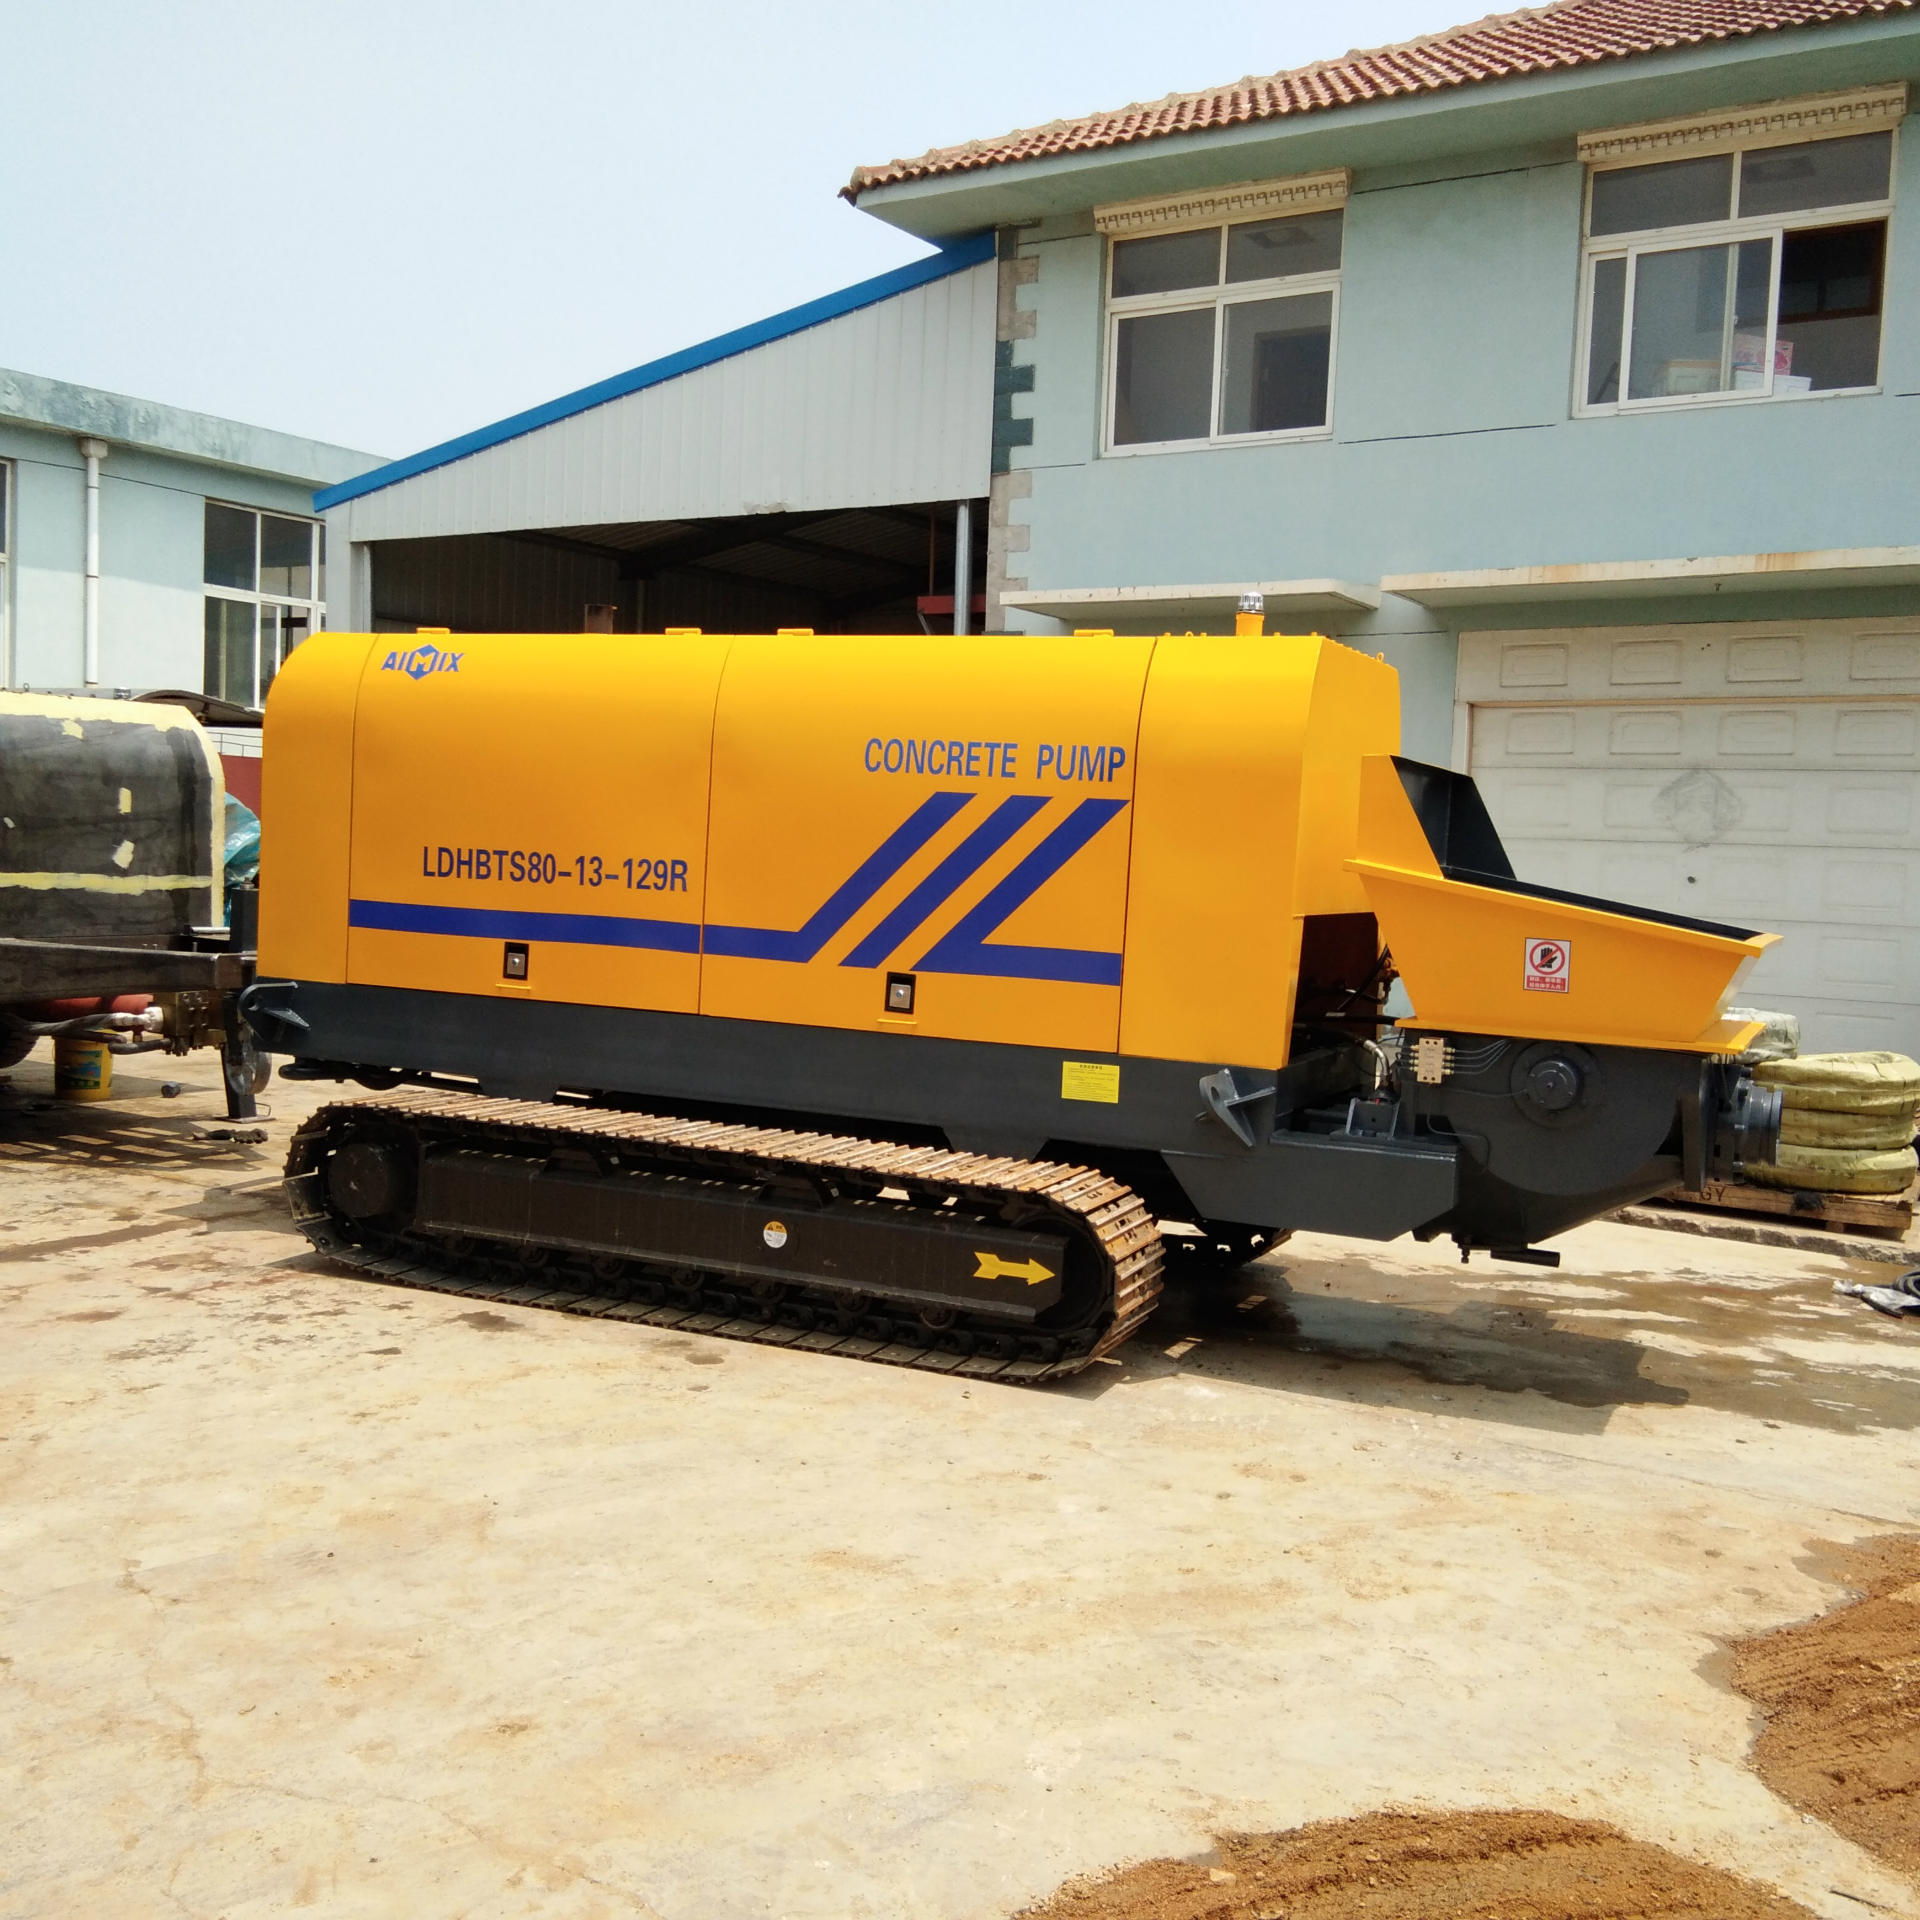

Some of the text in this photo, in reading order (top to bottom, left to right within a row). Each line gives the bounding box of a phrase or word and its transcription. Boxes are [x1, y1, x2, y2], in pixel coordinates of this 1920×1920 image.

[381, 644, 465, 680] AIMIX
[864, 737, 1126, 783] CONCRETE PUMP
[423, 846, 688, 892] LDHBTS80-13-129R
